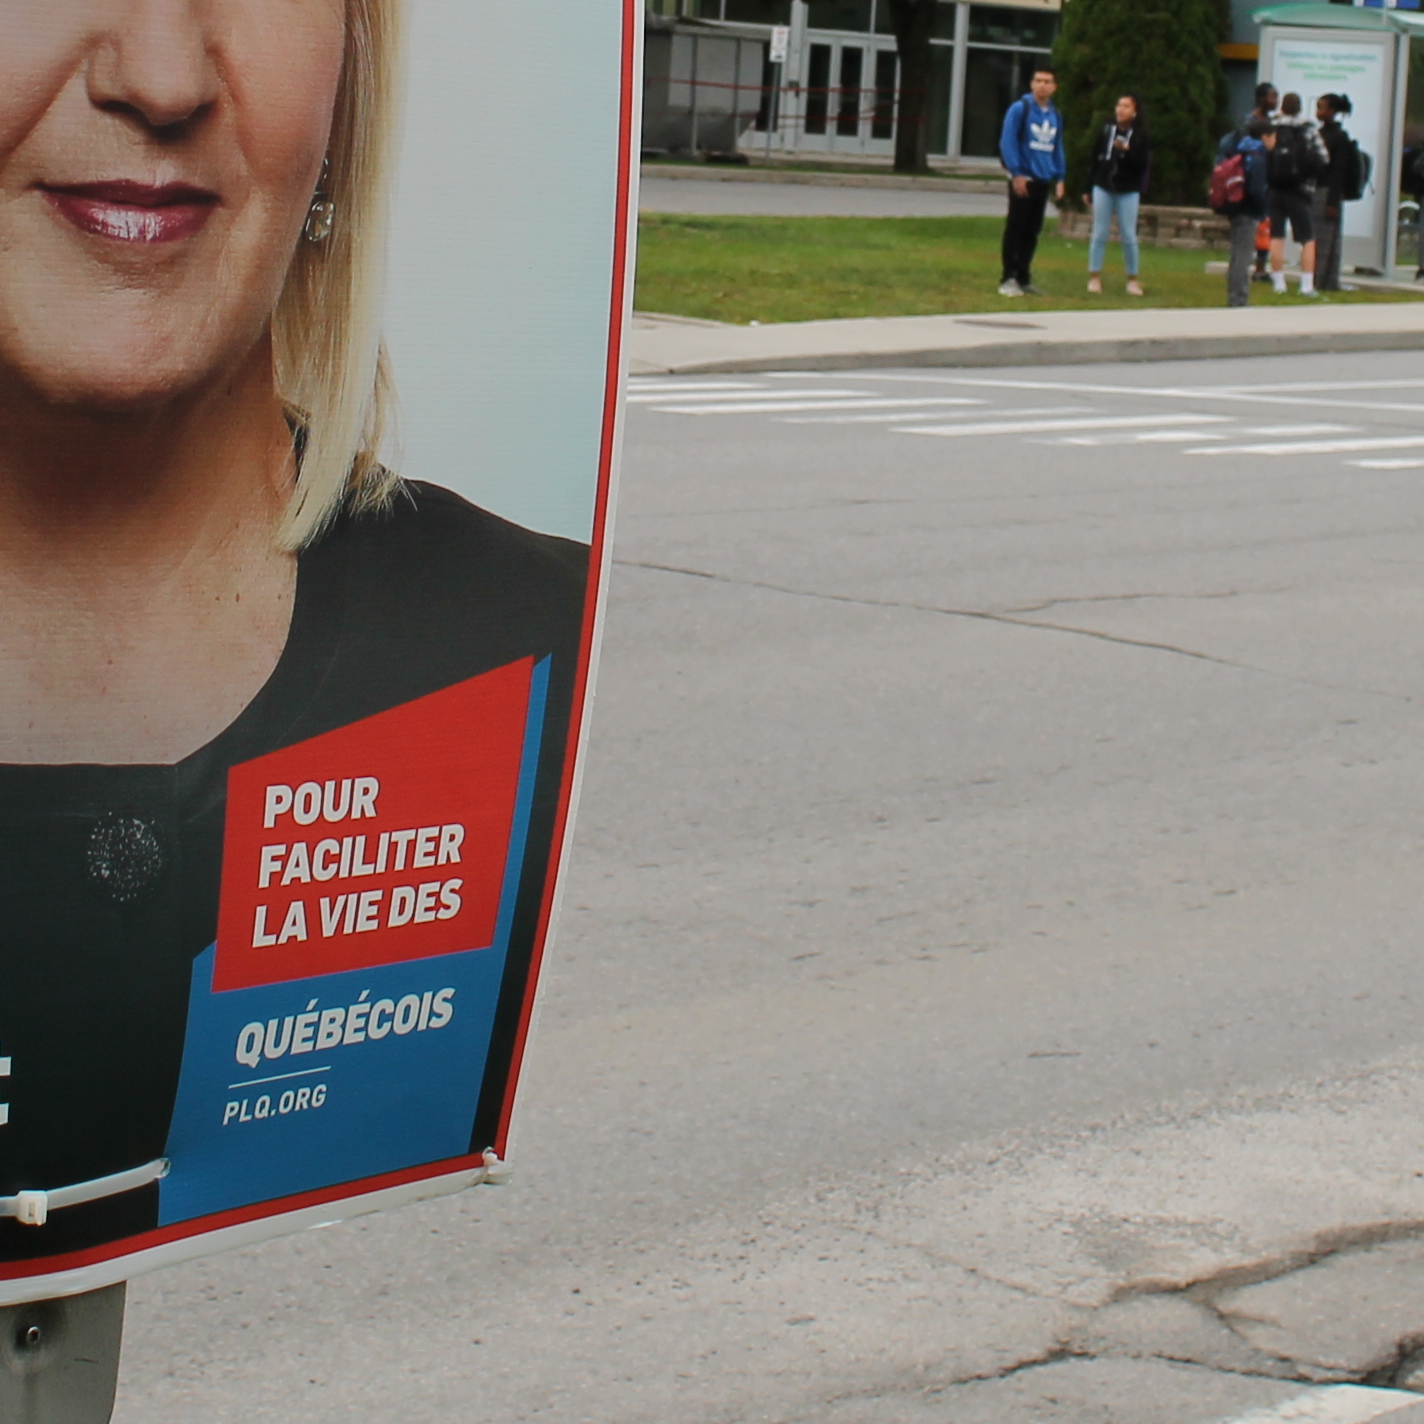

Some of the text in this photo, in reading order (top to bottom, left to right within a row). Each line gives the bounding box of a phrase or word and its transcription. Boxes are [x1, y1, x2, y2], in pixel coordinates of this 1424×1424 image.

[263, 776, 380, 830] POUR
[258, 823, 465, 890] FACILITER
[251, 878, 464, 949] LA VIE DES
[235, 986, 457, 1070] QUÉBÉCOIS
[221, 1082, 329, 1127] PLQ.ORG
